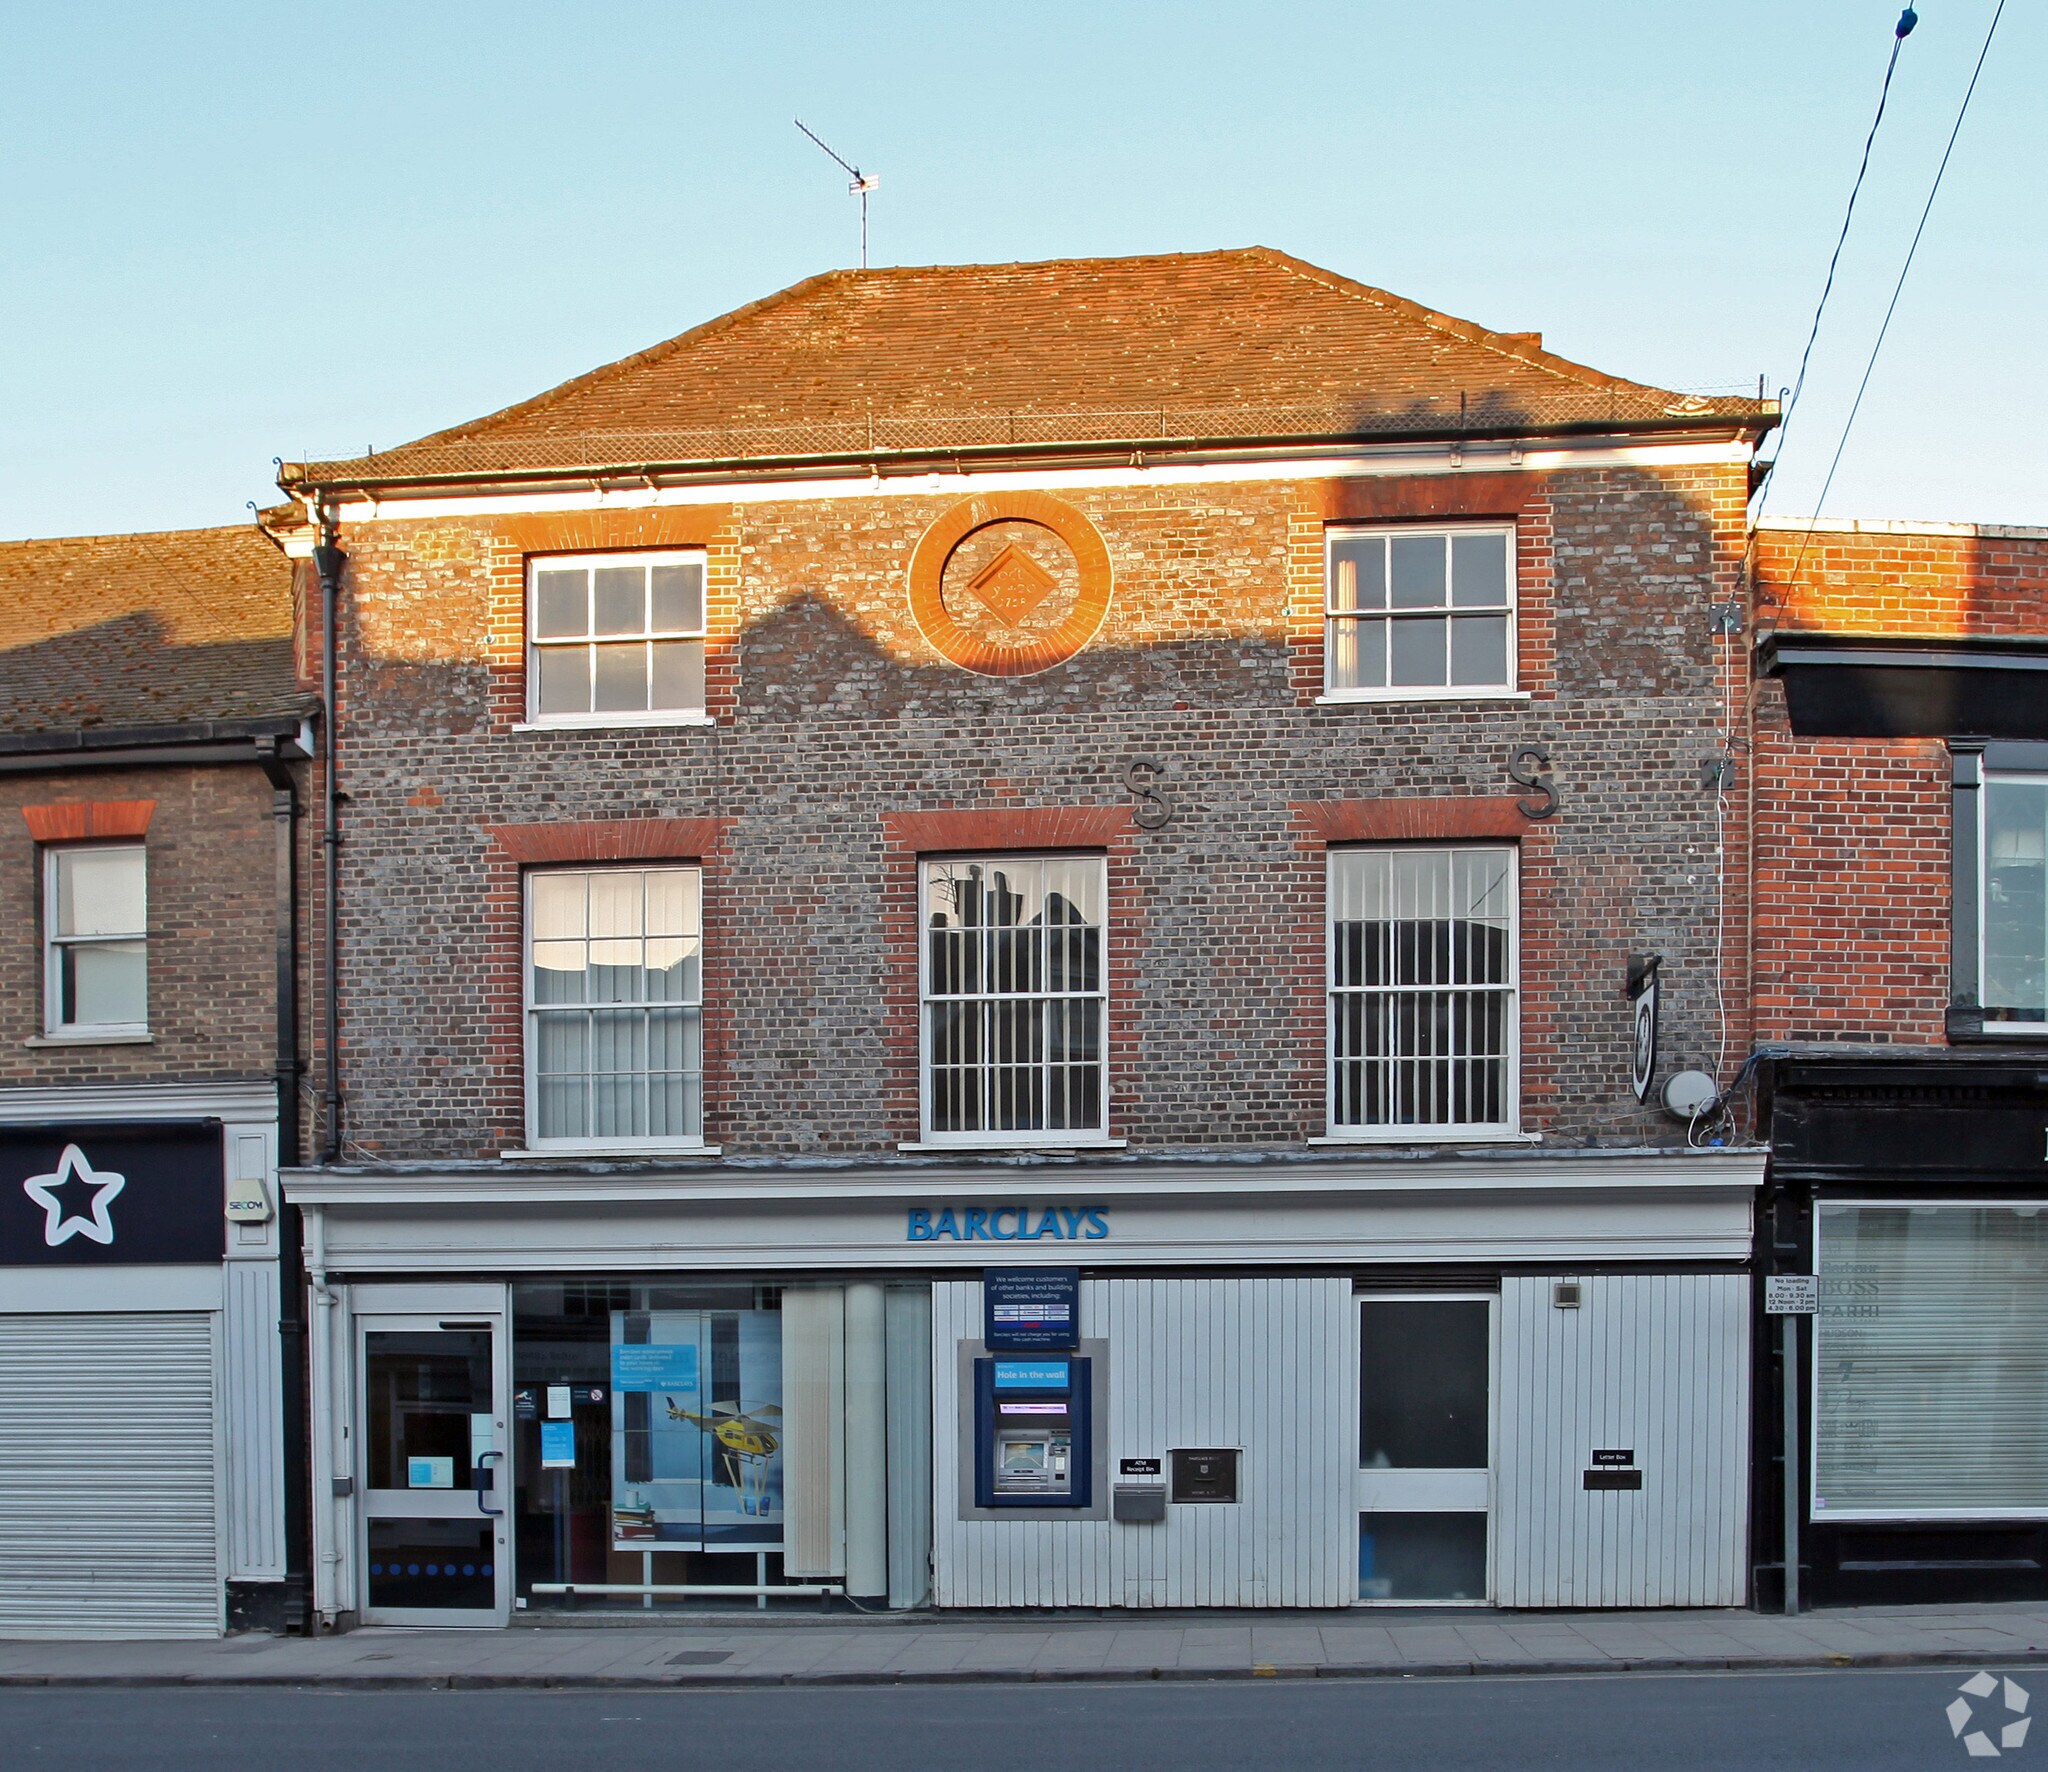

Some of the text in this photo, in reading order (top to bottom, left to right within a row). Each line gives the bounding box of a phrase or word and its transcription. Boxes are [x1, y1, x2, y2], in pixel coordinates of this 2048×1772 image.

[229, 1201, 263, 1210] SECOM
[906, 1206, 1110, 1241] BARCLAYS
[1821, 1280, 1879, 1295] BOSS
[1821, 1305, 1879, 1317] FARHI
[997, 1371, 1065, 1379] Hole in the wall
